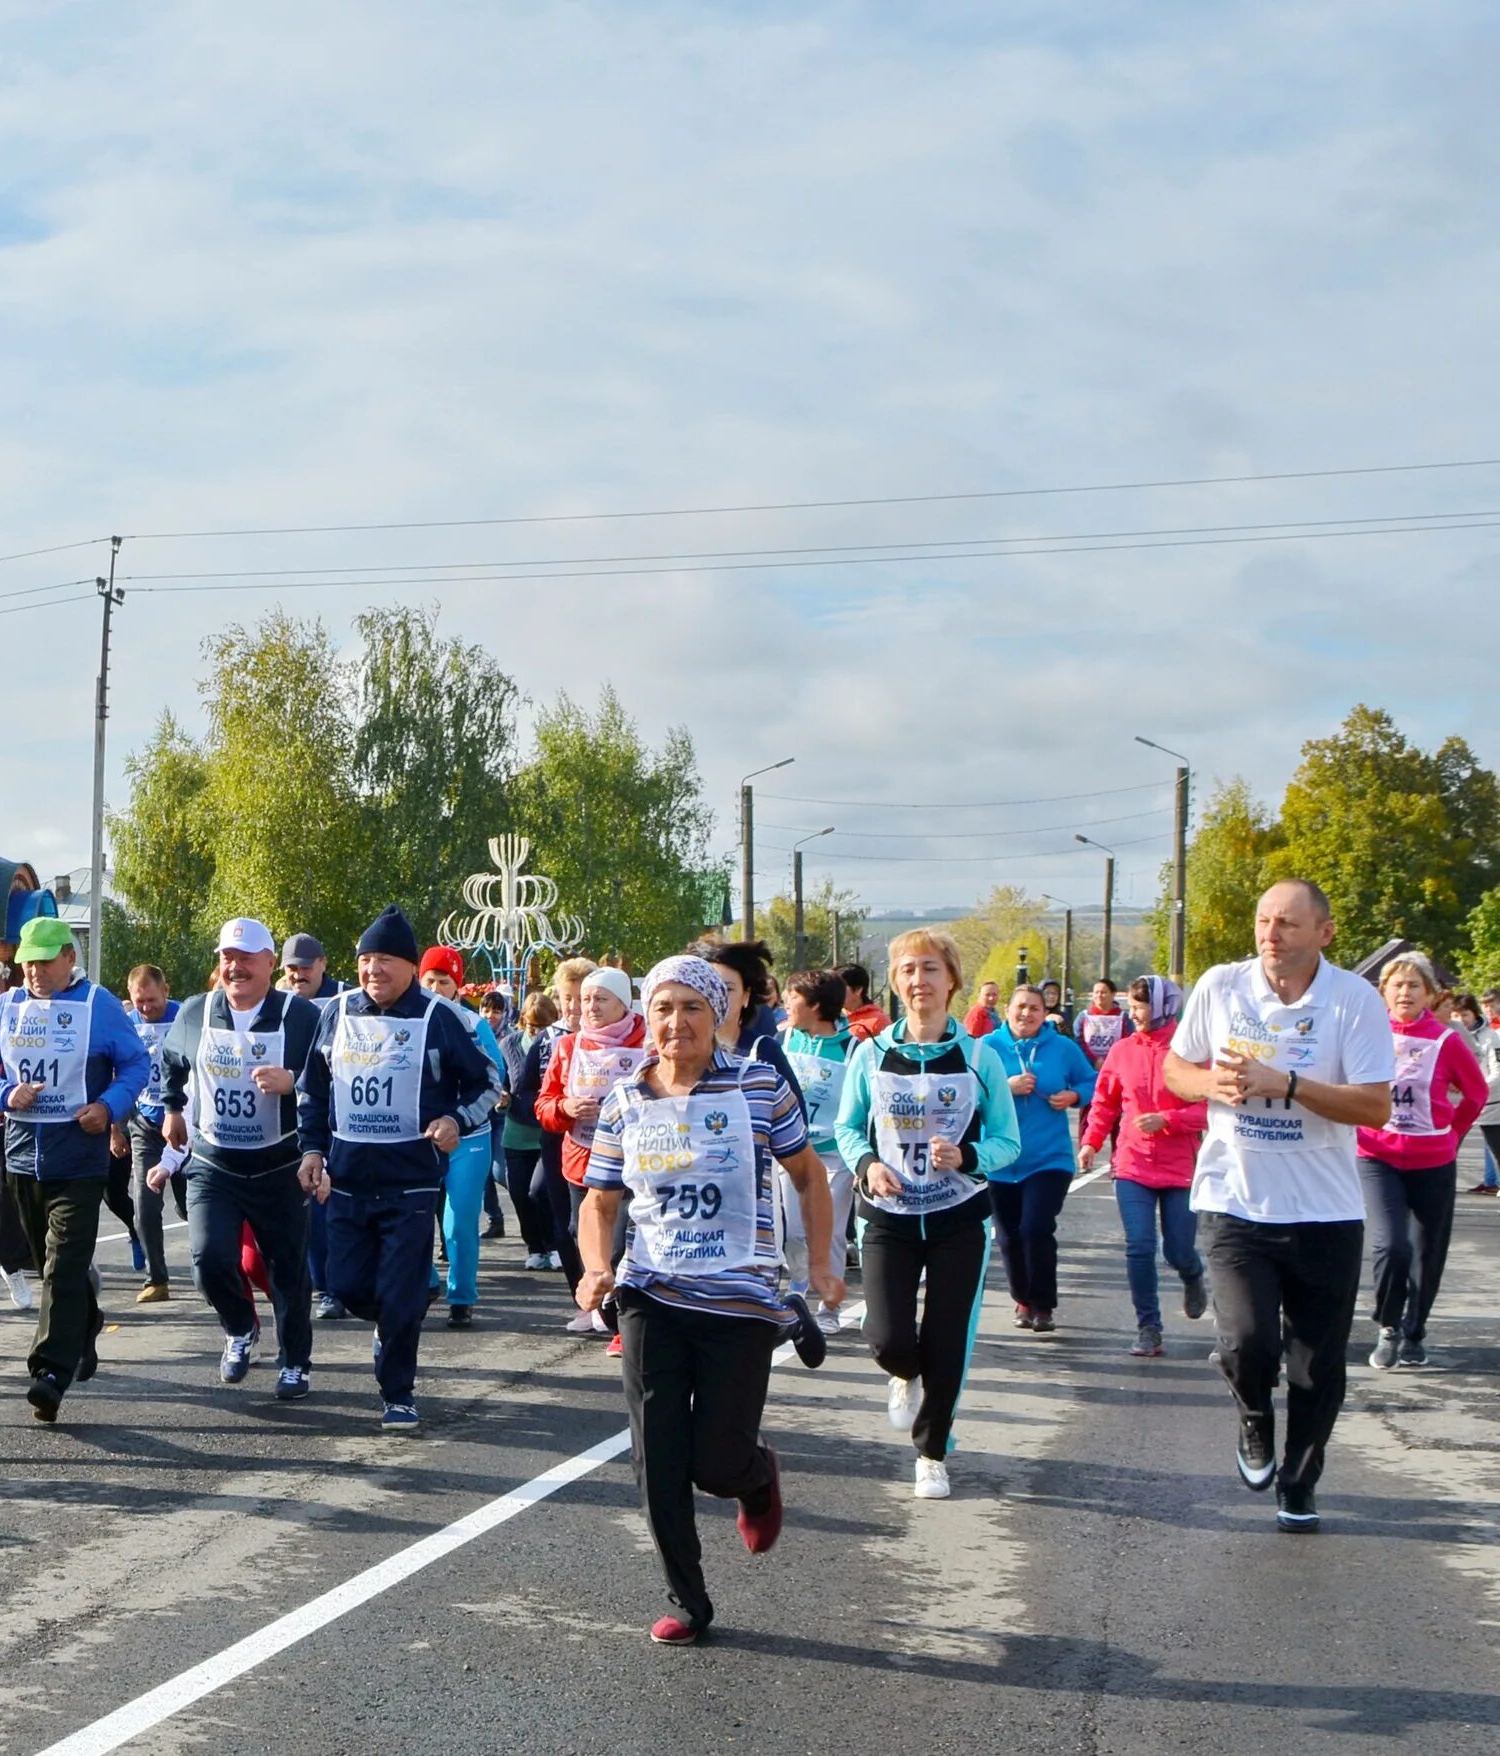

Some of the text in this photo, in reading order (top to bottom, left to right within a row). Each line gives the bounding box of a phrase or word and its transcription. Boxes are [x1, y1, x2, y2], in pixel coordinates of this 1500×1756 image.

[1232, 1011, 1269, 1033] КРОСС
[1229, 1022, 1279, 1042] НАЦИИ
[8, 1035, 47, 1048] 2020
[205, 1053, 241, 1066] НАЦИИ
[18, 1058, 59, 1088] 641
[206, 1063, 241, 1079] 2020
[351, 1075, 393, 1107] 661
[214, 1087, 256, 1119] 653
[881, 1102, 925, 1116] НАЦИИ
[348, 1113, 400, 1124] ЧУВАШСКАЯ
[883, 1116, 925, 1131] 2020
[1235, 1112, 1303, 1129] ЧУВАШСКАЯ
[348, 1123, 401, 1134] РЕСПУБЛИКА
[1234, 1125, 1304, 1141] РЕСПУБЛИКА
[637, 1152, 693, 1173] 2020
[896, 1142, 938, 1177] 75
[656, 1182, 722, 1220] 759
